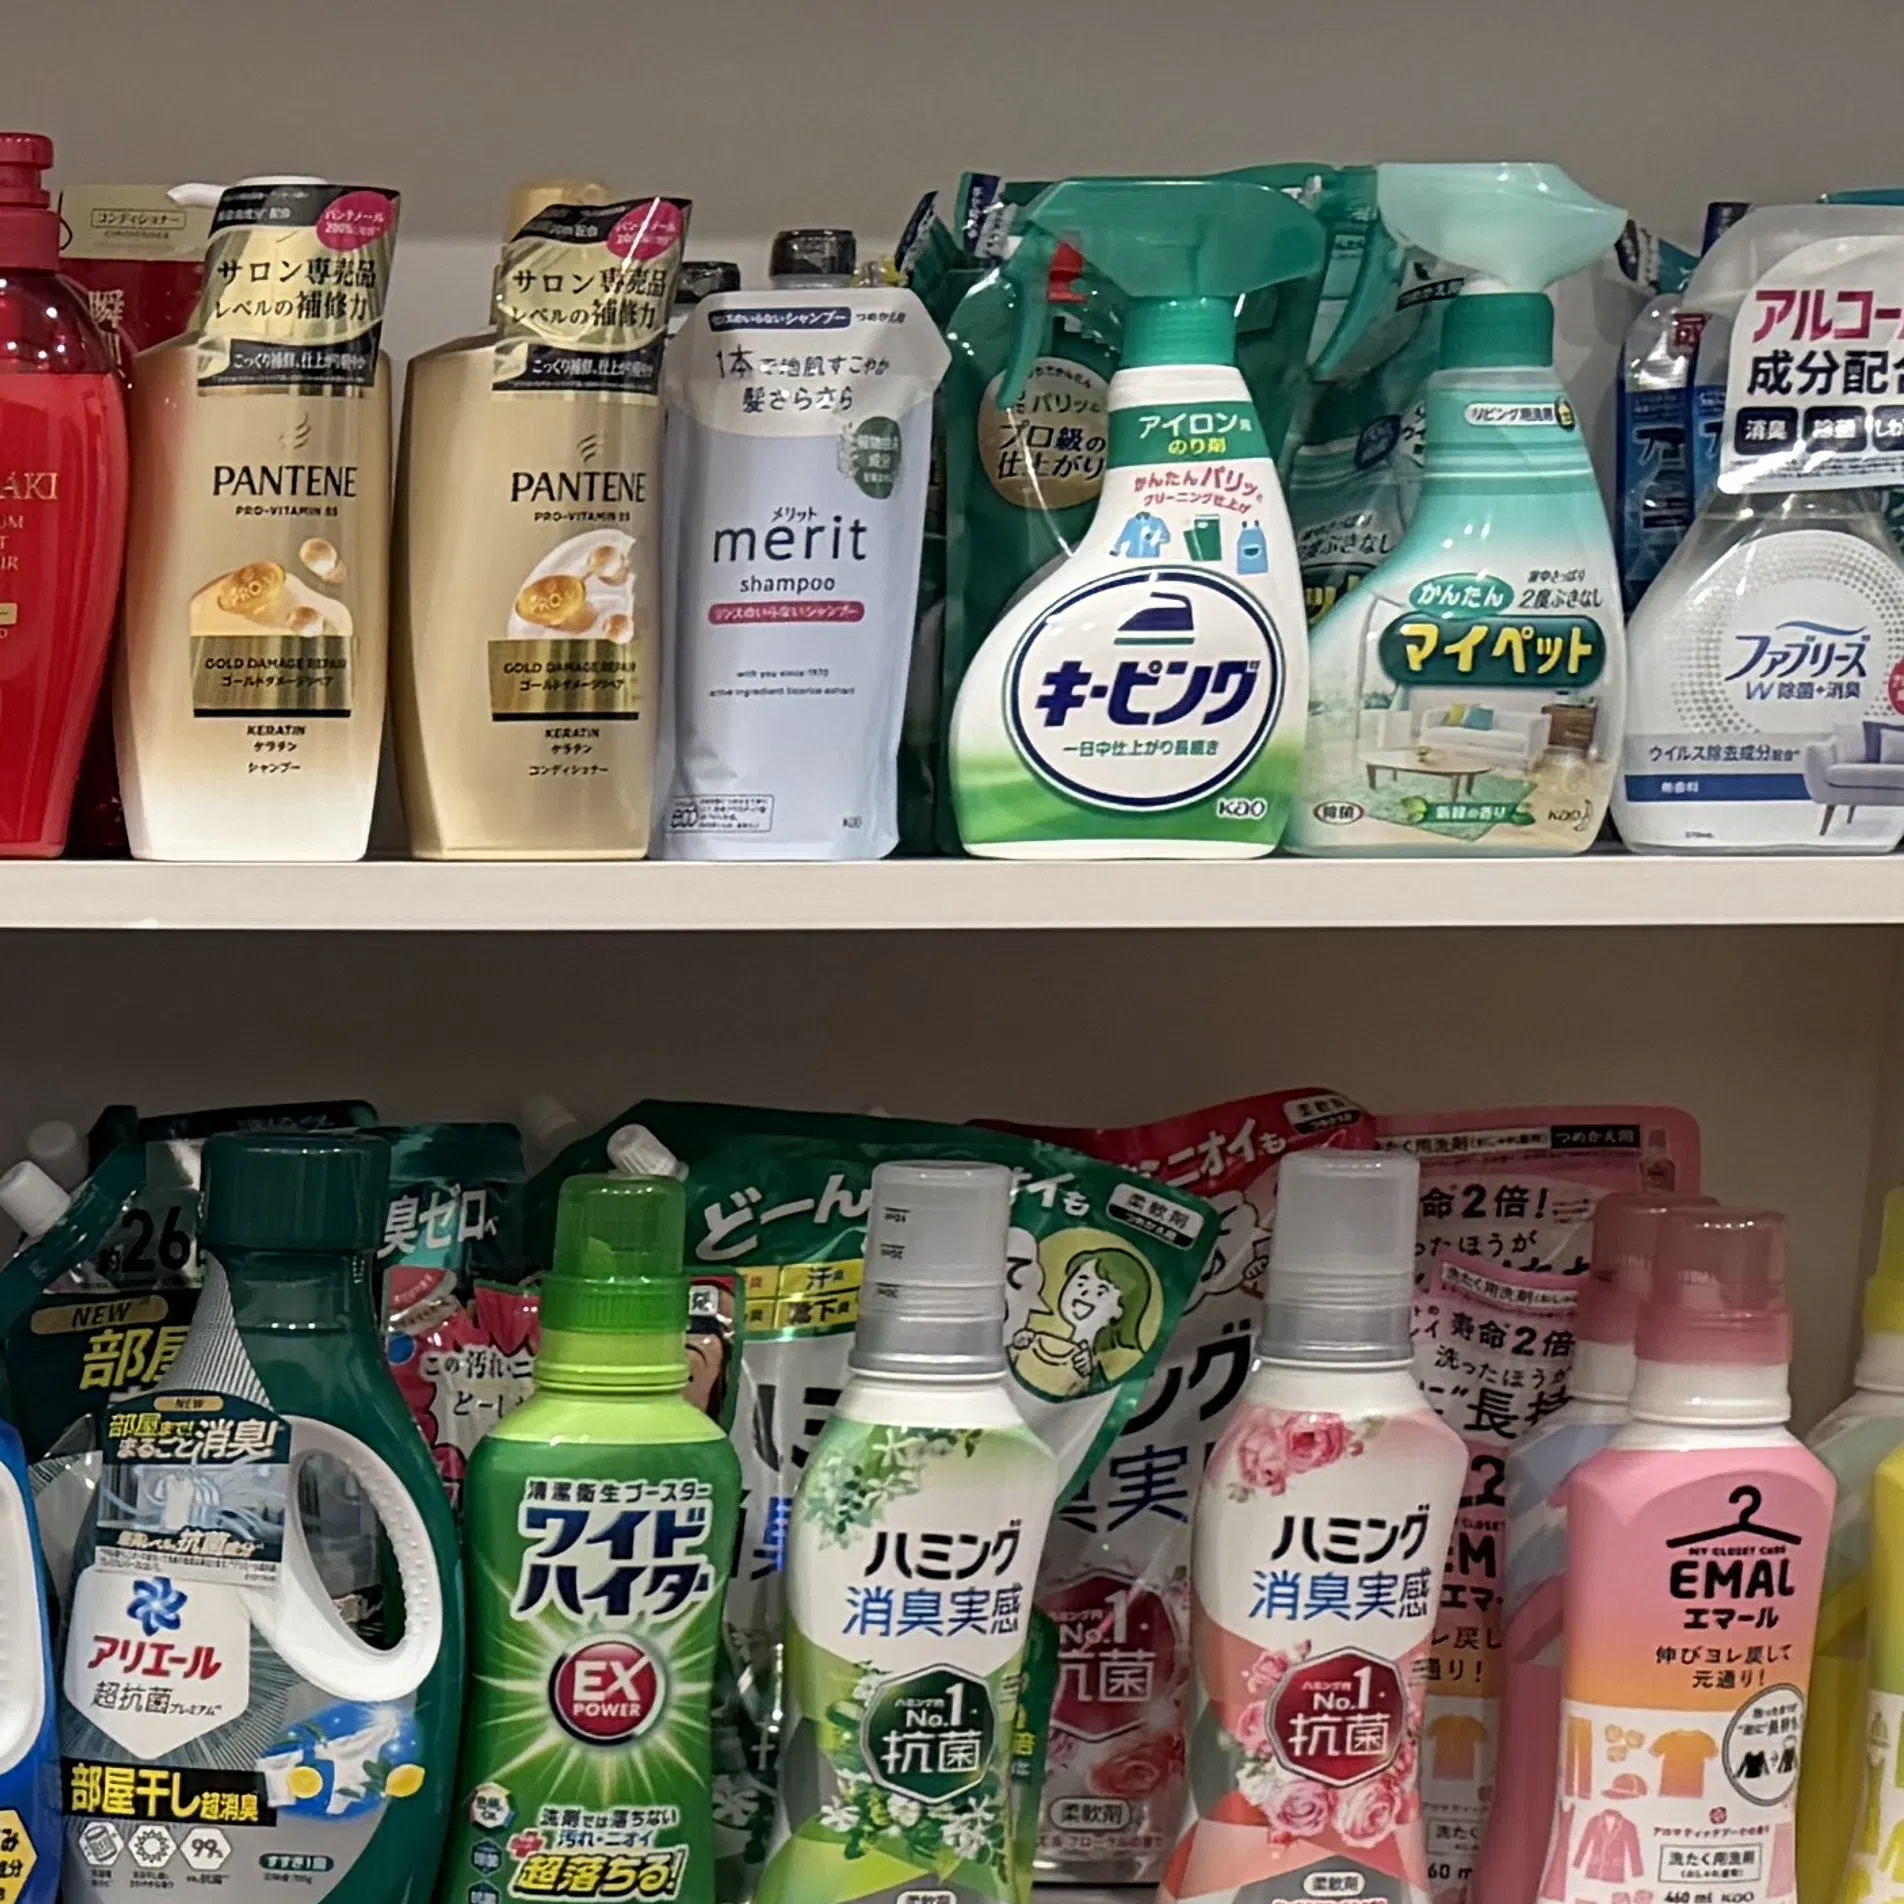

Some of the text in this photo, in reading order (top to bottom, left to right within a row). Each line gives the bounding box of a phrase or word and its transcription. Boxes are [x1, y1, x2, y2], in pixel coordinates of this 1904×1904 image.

[213, 464, 358, 499] PANTENE
[511, 471, 646, 503] PANTENE
[713, 518, 868, 562] merit
[740, 572, 836, 595] shampoo
[1414, 582, 1508, 610] かんたん
[1402, 625, 1593, 676] マイペット
[1728, 635, 1871, 681] ファブリーズ
[1036, 659, 1260, 728] キーピング
[521, 1507, 712, 1562] ワイド
[865, 1522, 1020, 1578] ハミング
[1272, 1505, 1432, 1562] ハミング
[1248, 1570, 1432, 1621] 消臭実感
[1669, 1557, 1796, 1601] EMAL
[843, 1586, 1022, 1636] 消臭実感
[1683, 1605, 1779, 1631] エマール
[87, 1636, 221, 1681] アリエール
[572, 1656, 646, 1701] EX
[572, 1700, 642, 1721] POWER
[880, 1729, 982, 1774] 抗菌
[1288, 1712, 1392, 1758] 抗菌
